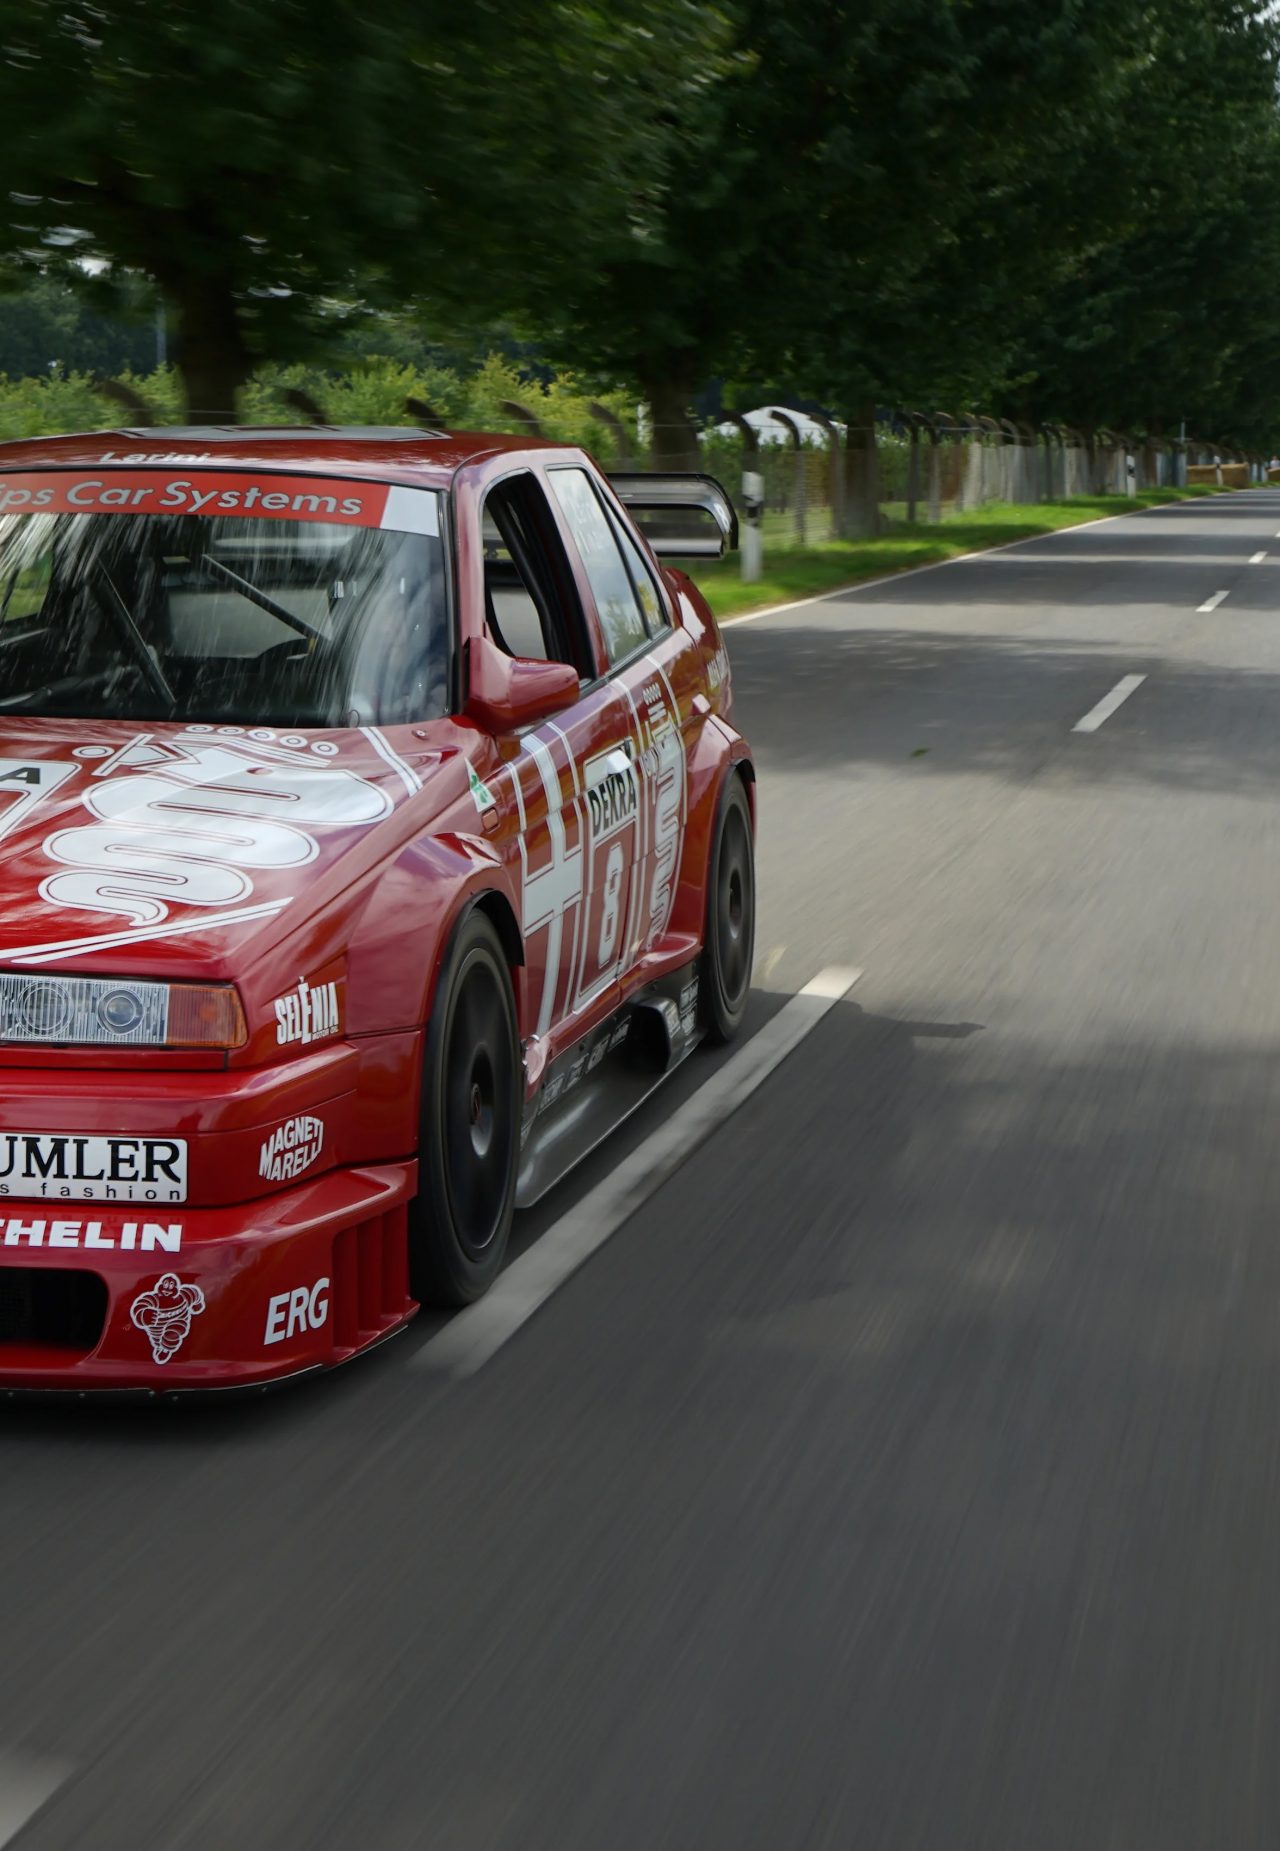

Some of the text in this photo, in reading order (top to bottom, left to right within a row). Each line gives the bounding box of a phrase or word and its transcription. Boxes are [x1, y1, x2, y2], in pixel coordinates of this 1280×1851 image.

[66, 481, 154, 506] Car
[159, 481, 363, 516] Systems
[588, 768, 637, 837] DEKRA
[597, 841, 623, 969] 8
[42, 1182, 181, 1200] fashion
[263, 1277, 330, 1345] ERG
